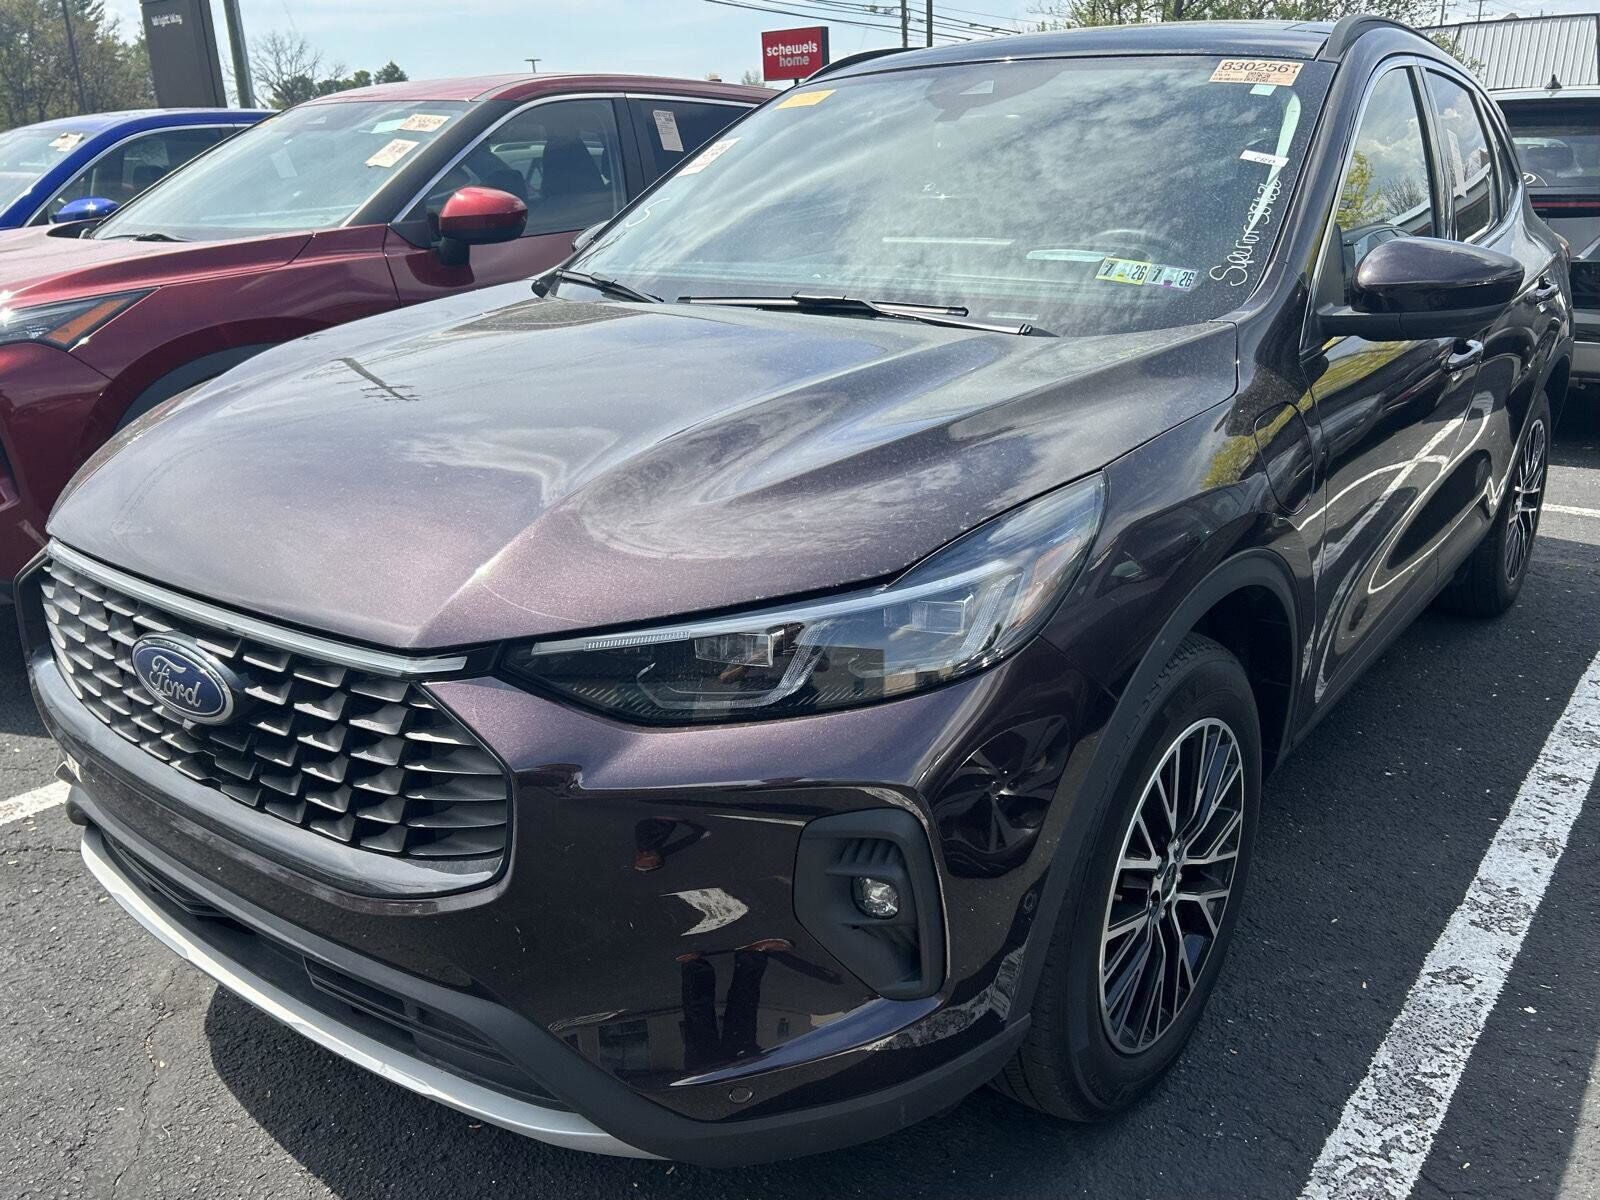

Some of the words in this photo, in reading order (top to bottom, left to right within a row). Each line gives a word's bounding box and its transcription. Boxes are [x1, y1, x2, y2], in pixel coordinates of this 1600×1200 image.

[766, 41, 818, 56] schewels
[779, 55, 809, 67] home
[1221, 62, 1298, 73] 8302561
[1131, 265, 1147, 280] 26
[1179, 271, 1195, 287] 26
[149, 655, 202, 708] Ford
